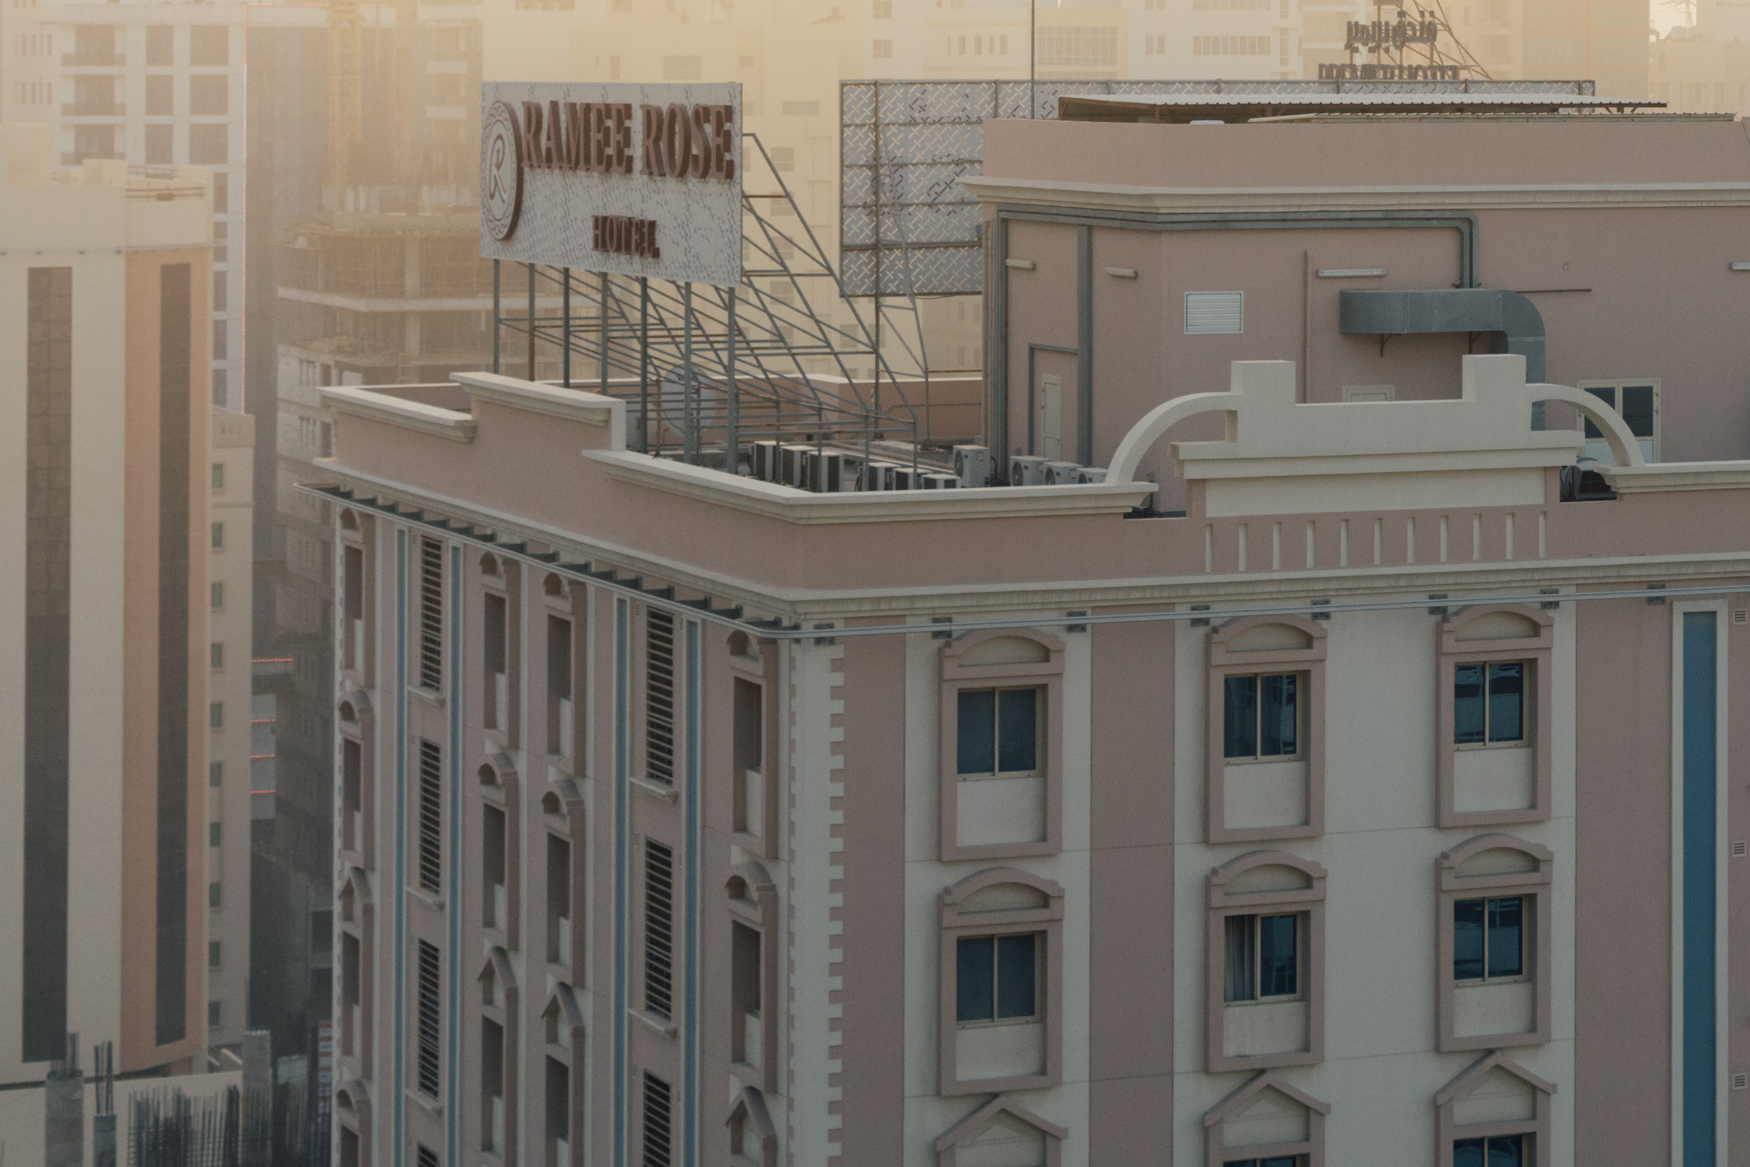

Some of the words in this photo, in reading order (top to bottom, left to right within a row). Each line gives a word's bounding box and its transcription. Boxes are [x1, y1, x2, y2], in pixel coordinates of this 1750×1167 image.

[1392, 11, 1437, 50] فندق
[521, 100, 634, 173] RAMEE
[640, 103, 734, 180] ROSE
[591, 215, 660, 258] HOTEL
